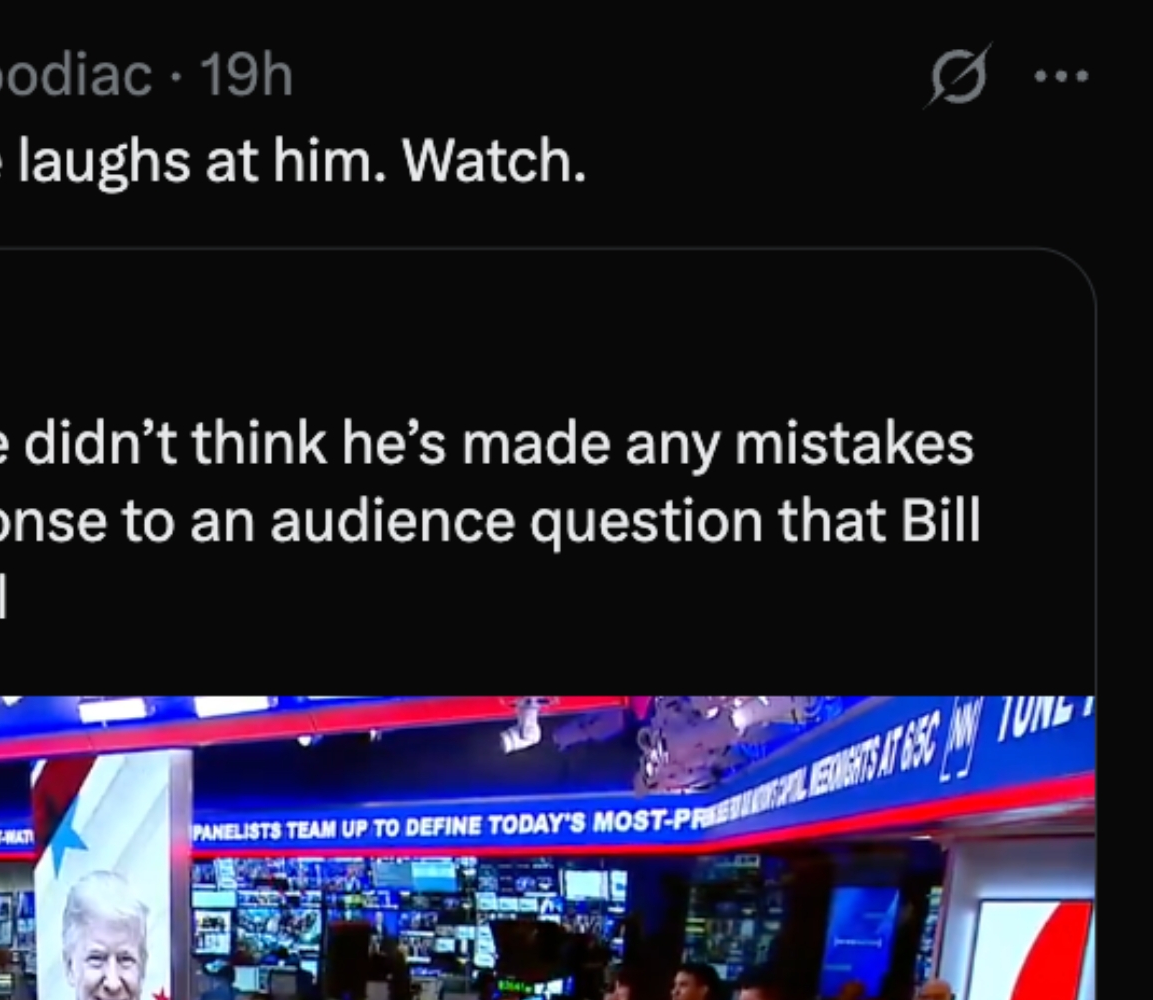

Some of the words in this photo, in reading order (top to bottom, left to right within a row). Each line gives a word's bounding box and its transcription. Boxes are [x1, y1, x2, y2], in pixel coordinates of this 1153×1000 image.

[202, 50, 291, 96] 19h
[21, 135, 190, 194] laughs
[206, 140, 259, 183] at
[275, 135, 386, 182] him.
[402, 135, 585, 183] Watch.
[25, 418, 177, 465] didn’t
[191, 418, 328, 465] think
[344, 418, 446, 465] he’s
[465, 418, 610, 465] made
[627, 430, 721, 477] any
[737, 418, 974, 465] mistakes
[120, 500, 175, 543] to
[191, 508, 253, 543] an
[271, 495, 515, 543] audience
[530, 496, 761, 554] question
[777, 495, 886, 543] that
[903, 495, 979, 542] Bill
[192, 820, 282, 842] PANELISTS
[287, 819, 336, 840] TEAM
[342, 818, 368, 839] UP
[373, 817, 400, 838] TO
[406, 815, 482, 837] DEFINE
[488, 812, 585, 835] TODAY'S
